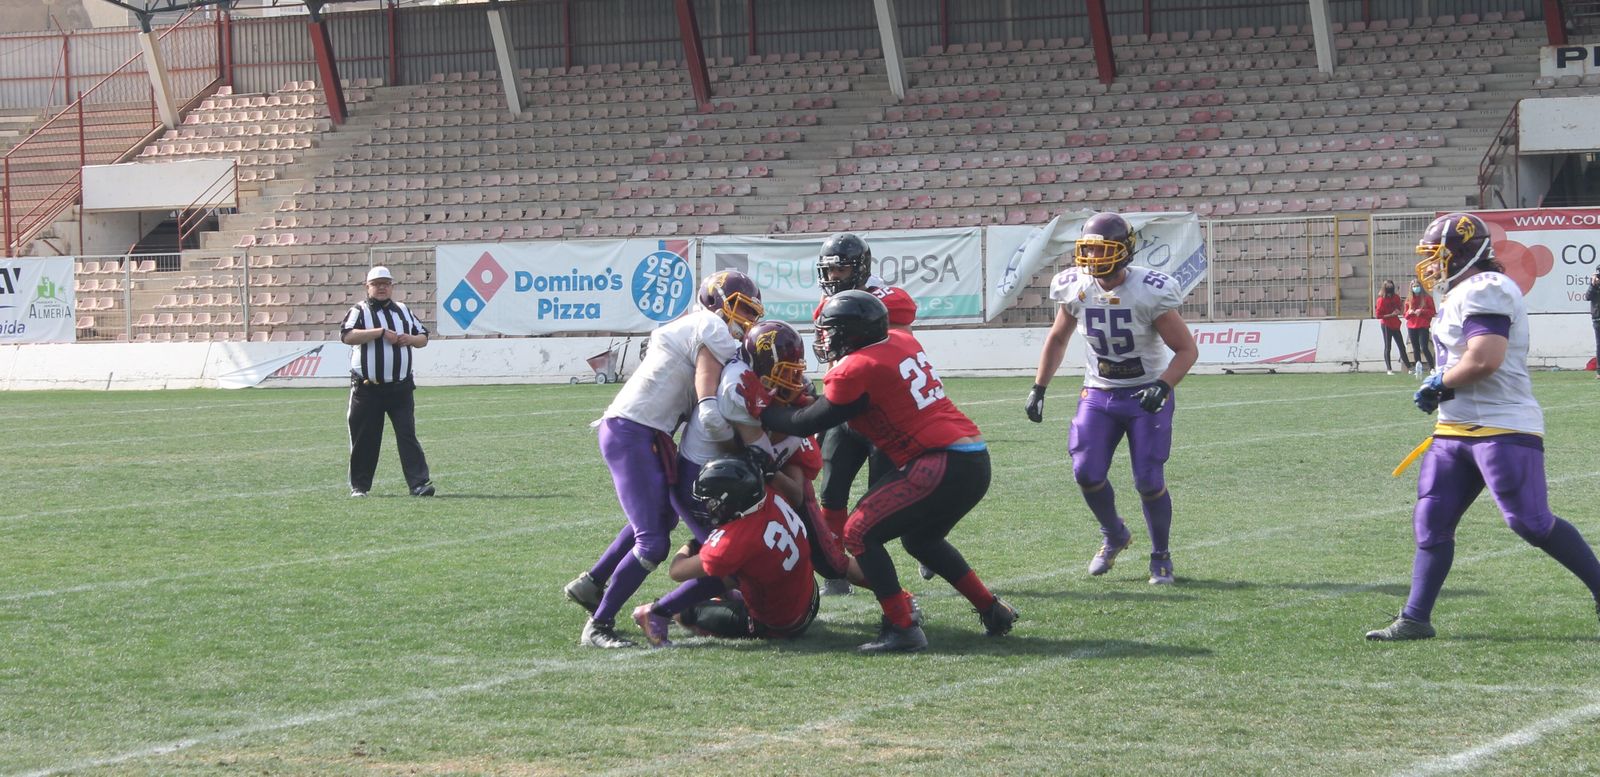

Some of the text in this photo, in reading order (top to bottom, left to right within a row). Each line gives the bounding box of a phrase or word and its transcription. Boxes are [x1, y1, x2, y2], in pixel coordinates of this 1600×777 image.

[1557, 46, 1600, 69] P
[1513, 214, 1600, 227] www.co
[515, 267, 623, 292] Domino's
[646, 255, 687, 280] 950
[756, 253, 960, 289] GRU OPSA
[1143, 270, 1169, 290] 55
[641, 272, 683, 299] 750
[537, 296, 600, 320] Pizza
[638, 292, 676, 317] 681
[1085, 308, 1135, 356] 55
[1193, 328, 1261, 344] indra
[899, 351, 946, 411] 23
[762, 493, 808, 572] 34
